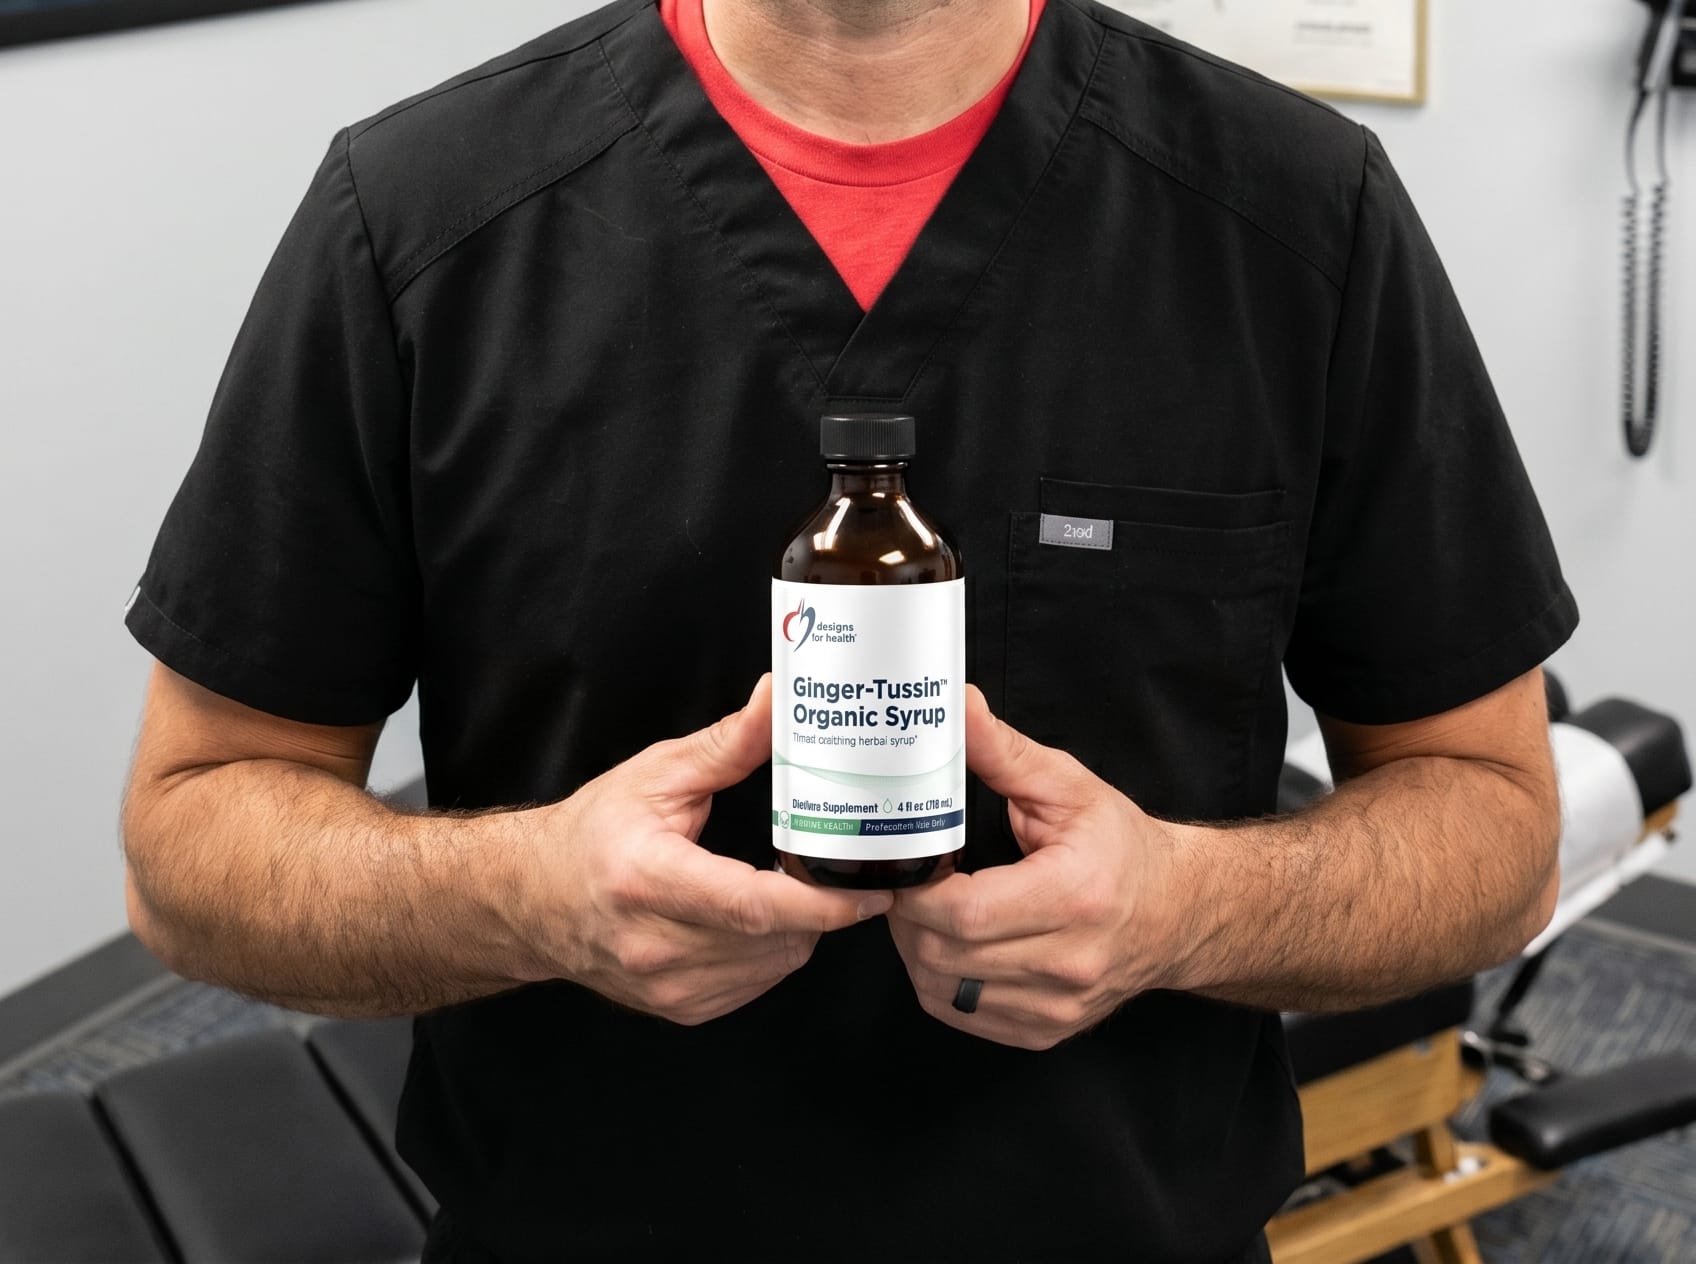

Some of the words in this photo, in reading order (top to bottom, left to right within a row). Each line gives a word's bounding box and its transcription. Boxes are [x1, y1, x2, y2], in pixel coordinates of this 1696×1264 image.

[816, 621, 854, 634] designs
[811, 633, 824, 642] for
[793, 703, 878, 730] Organic
[885, 705, 946, 731] Syrup
[822, 801, 879, 815] Supplement
[897, 802, 904, 813] 4
